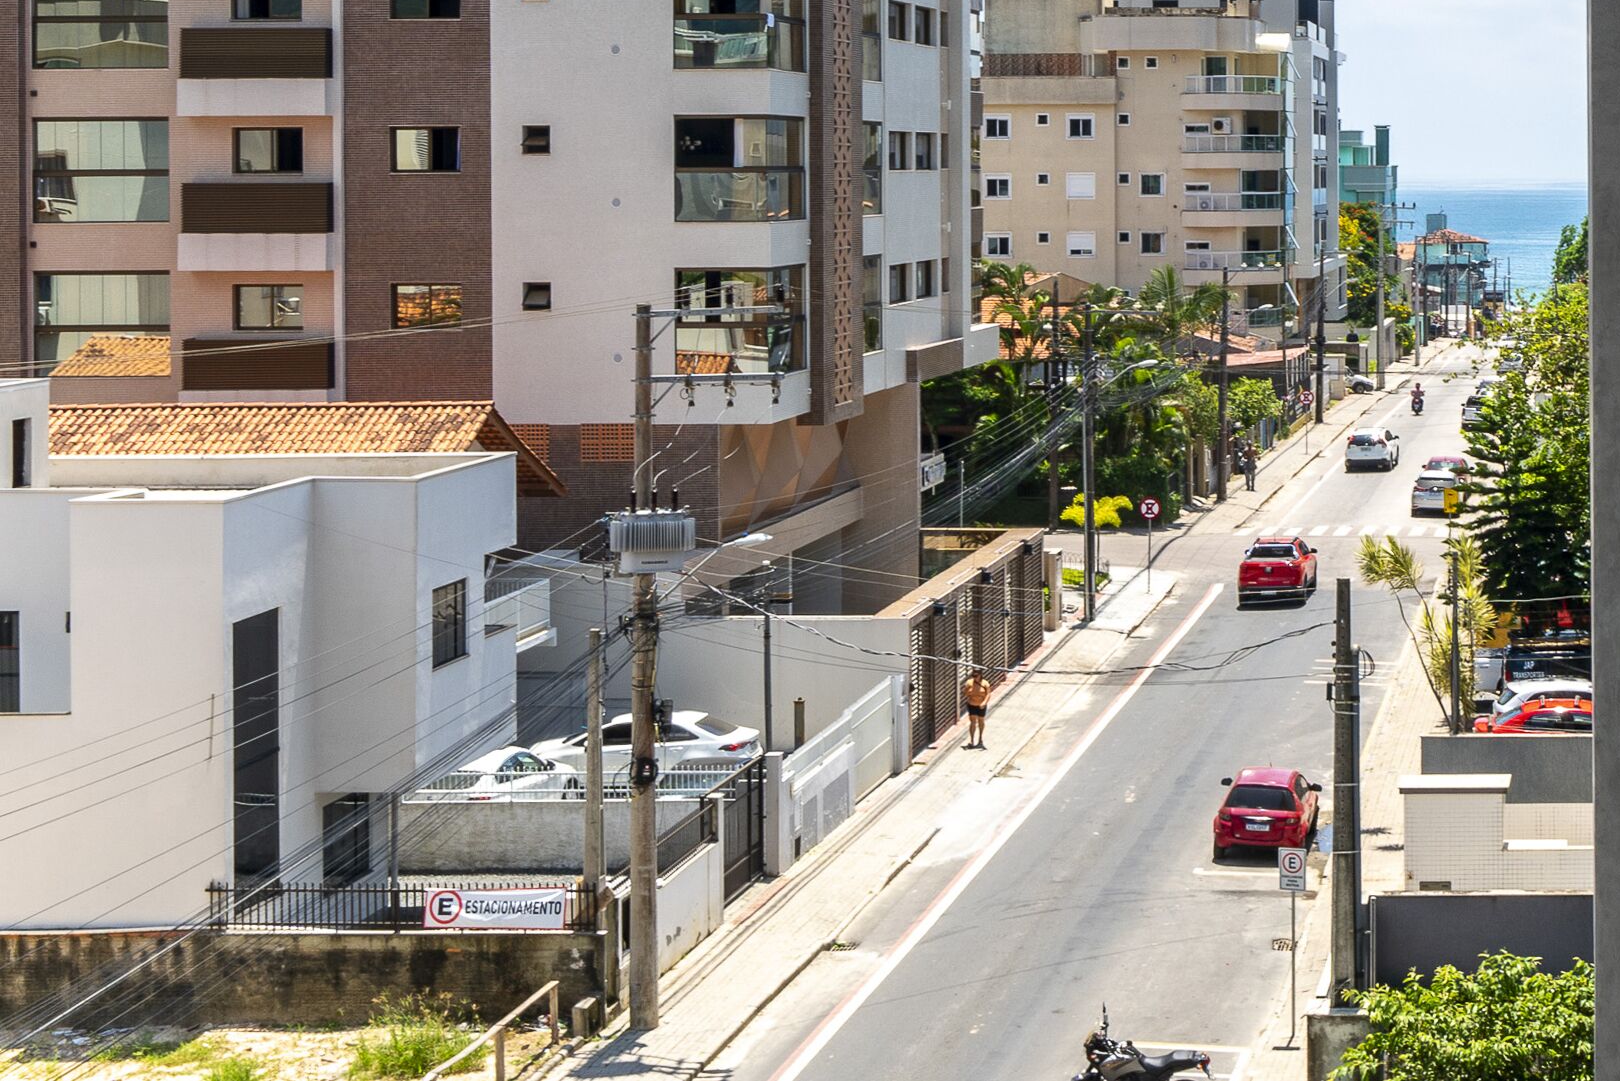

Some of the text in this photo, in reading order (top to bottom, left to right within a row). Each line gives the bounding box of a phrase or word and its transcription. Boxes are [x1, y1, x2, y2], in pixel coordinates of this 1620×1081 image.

[1288, 856, 1297, 870] E
[437, 897, 562, 916] E ESTACIONAMENTO
